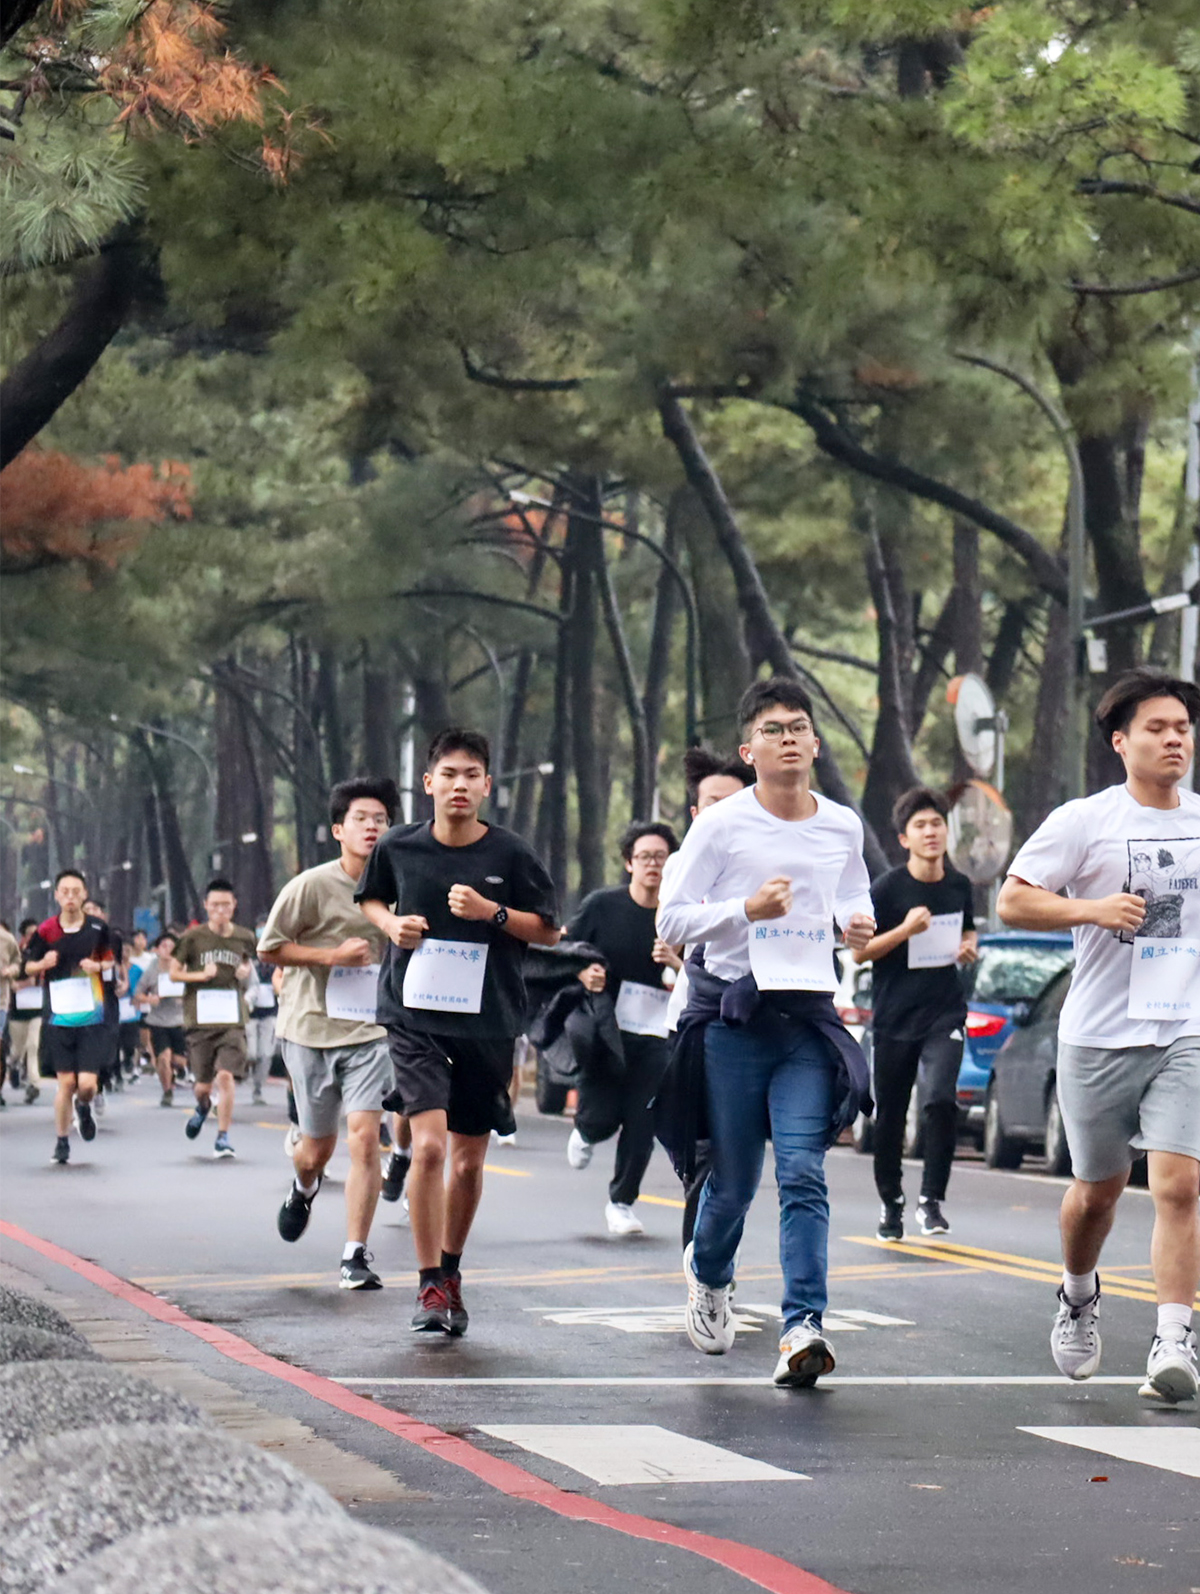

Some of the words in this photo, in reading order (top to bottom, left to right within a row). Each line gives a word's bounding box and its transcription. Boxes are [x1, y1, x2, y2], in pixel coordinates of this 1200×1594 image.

[755, 926, 826, 943] 國立中央大學
